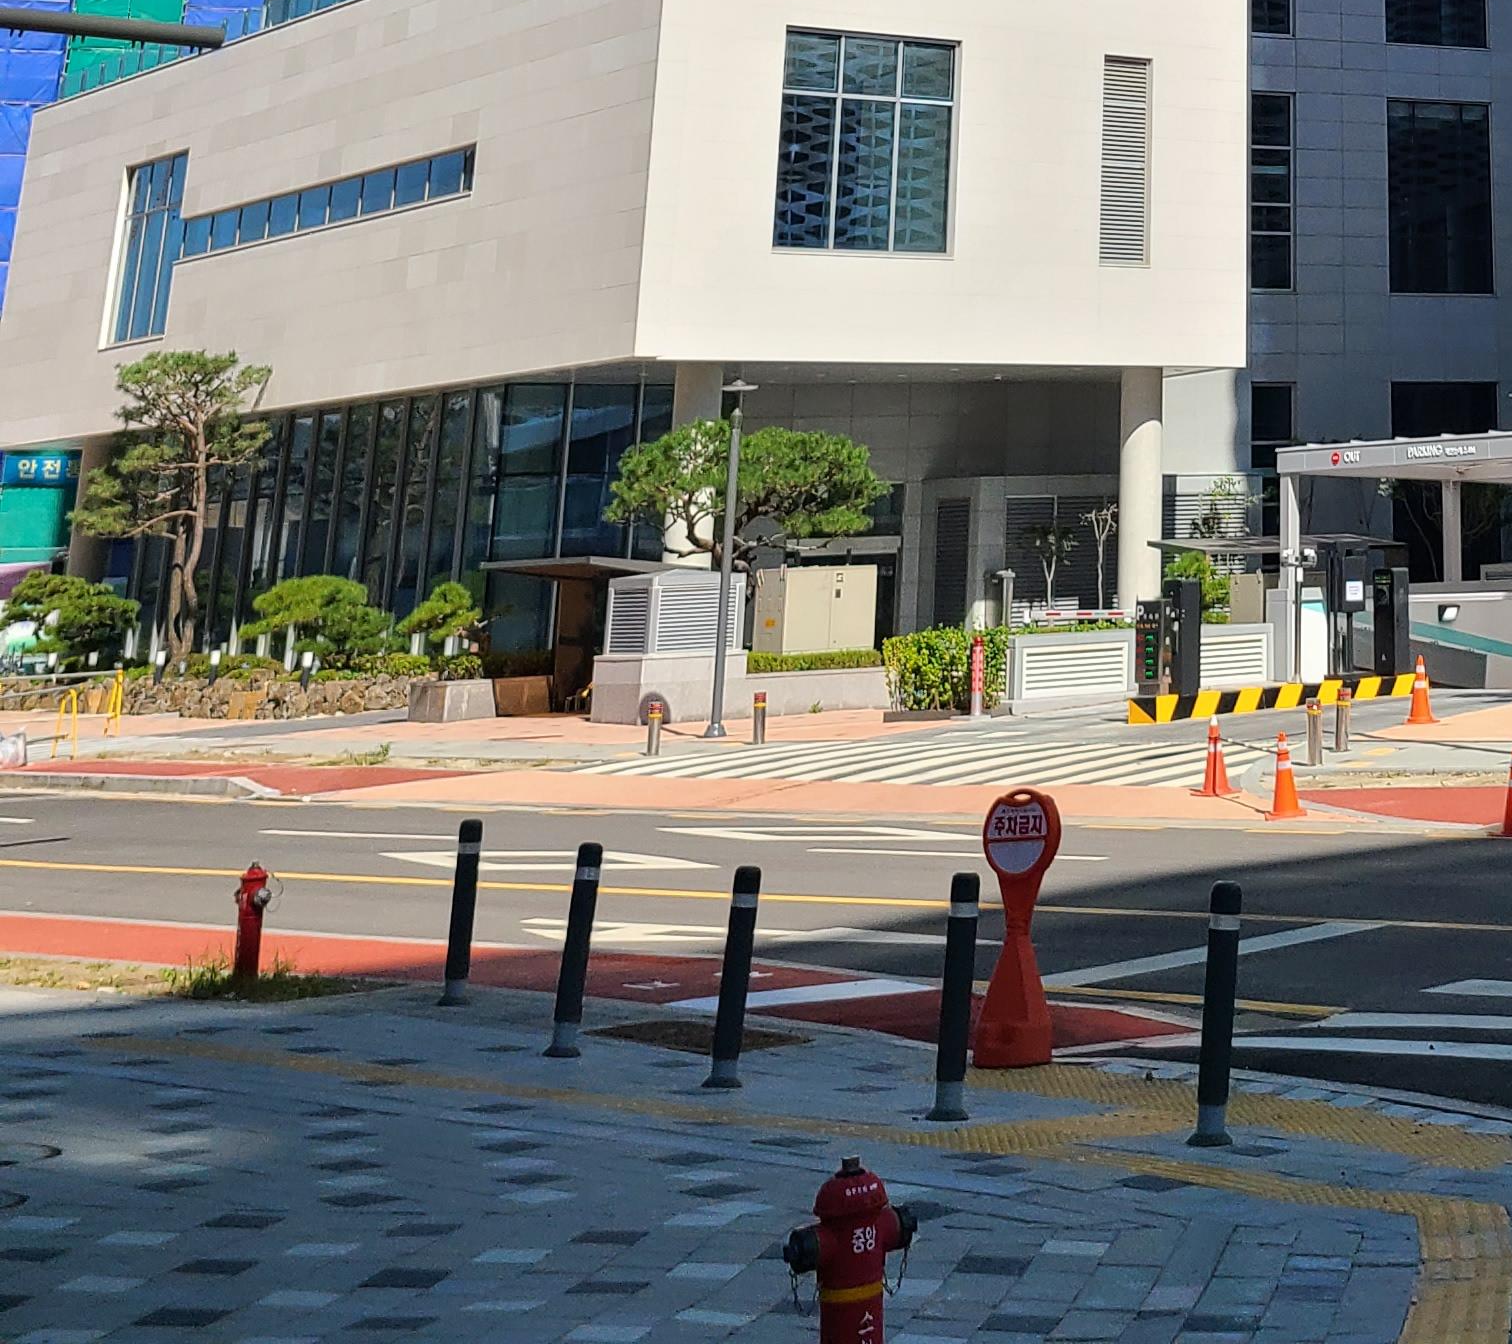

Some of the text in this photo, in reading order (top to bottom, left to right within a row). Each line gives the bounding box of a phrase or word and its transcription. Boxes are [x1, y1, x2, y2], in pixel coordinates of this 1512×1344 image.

[1343, 450, 1361, 462] OUT
[1407, 444, 1443, 458] PARKING
[994, 814, 1043, 836] 주차금지
[852, 1224, 876, 1254] 중앙
